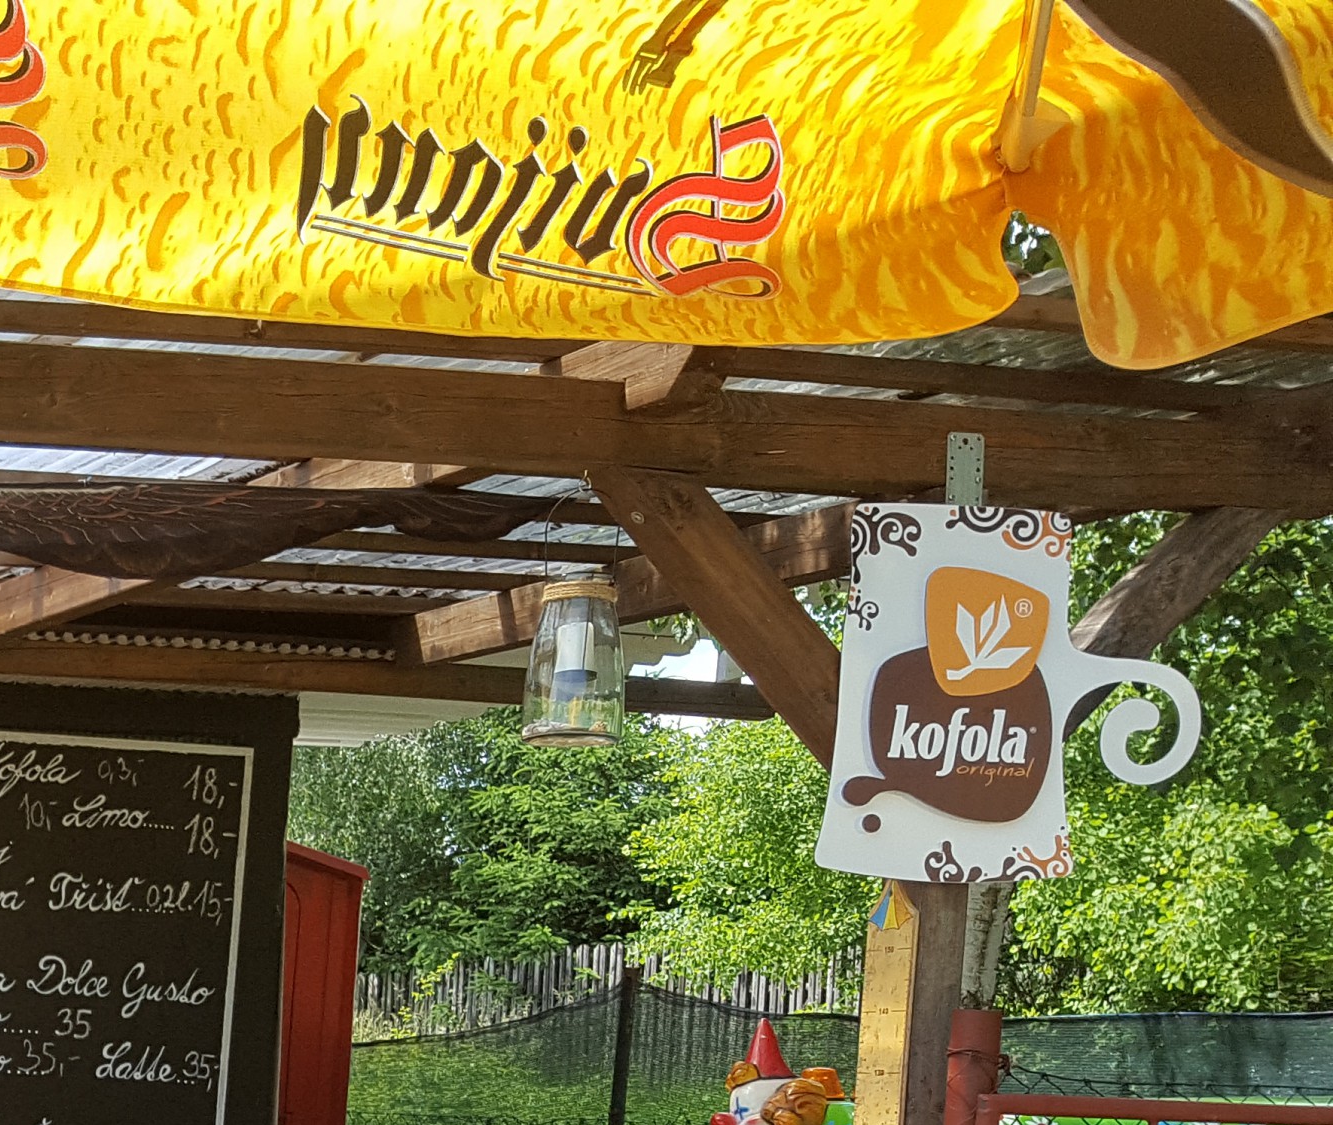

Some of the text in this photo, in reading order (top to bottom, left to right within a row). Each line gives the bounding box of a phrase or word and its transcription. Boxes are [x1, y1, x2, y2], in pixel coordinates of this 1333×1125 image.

[887, 704, 1028, 777] kofola
[956, 758, 1035, 787] original
[26, 955, 111, 999] Dolce
[122, 963, 215, 1018] Gusto
